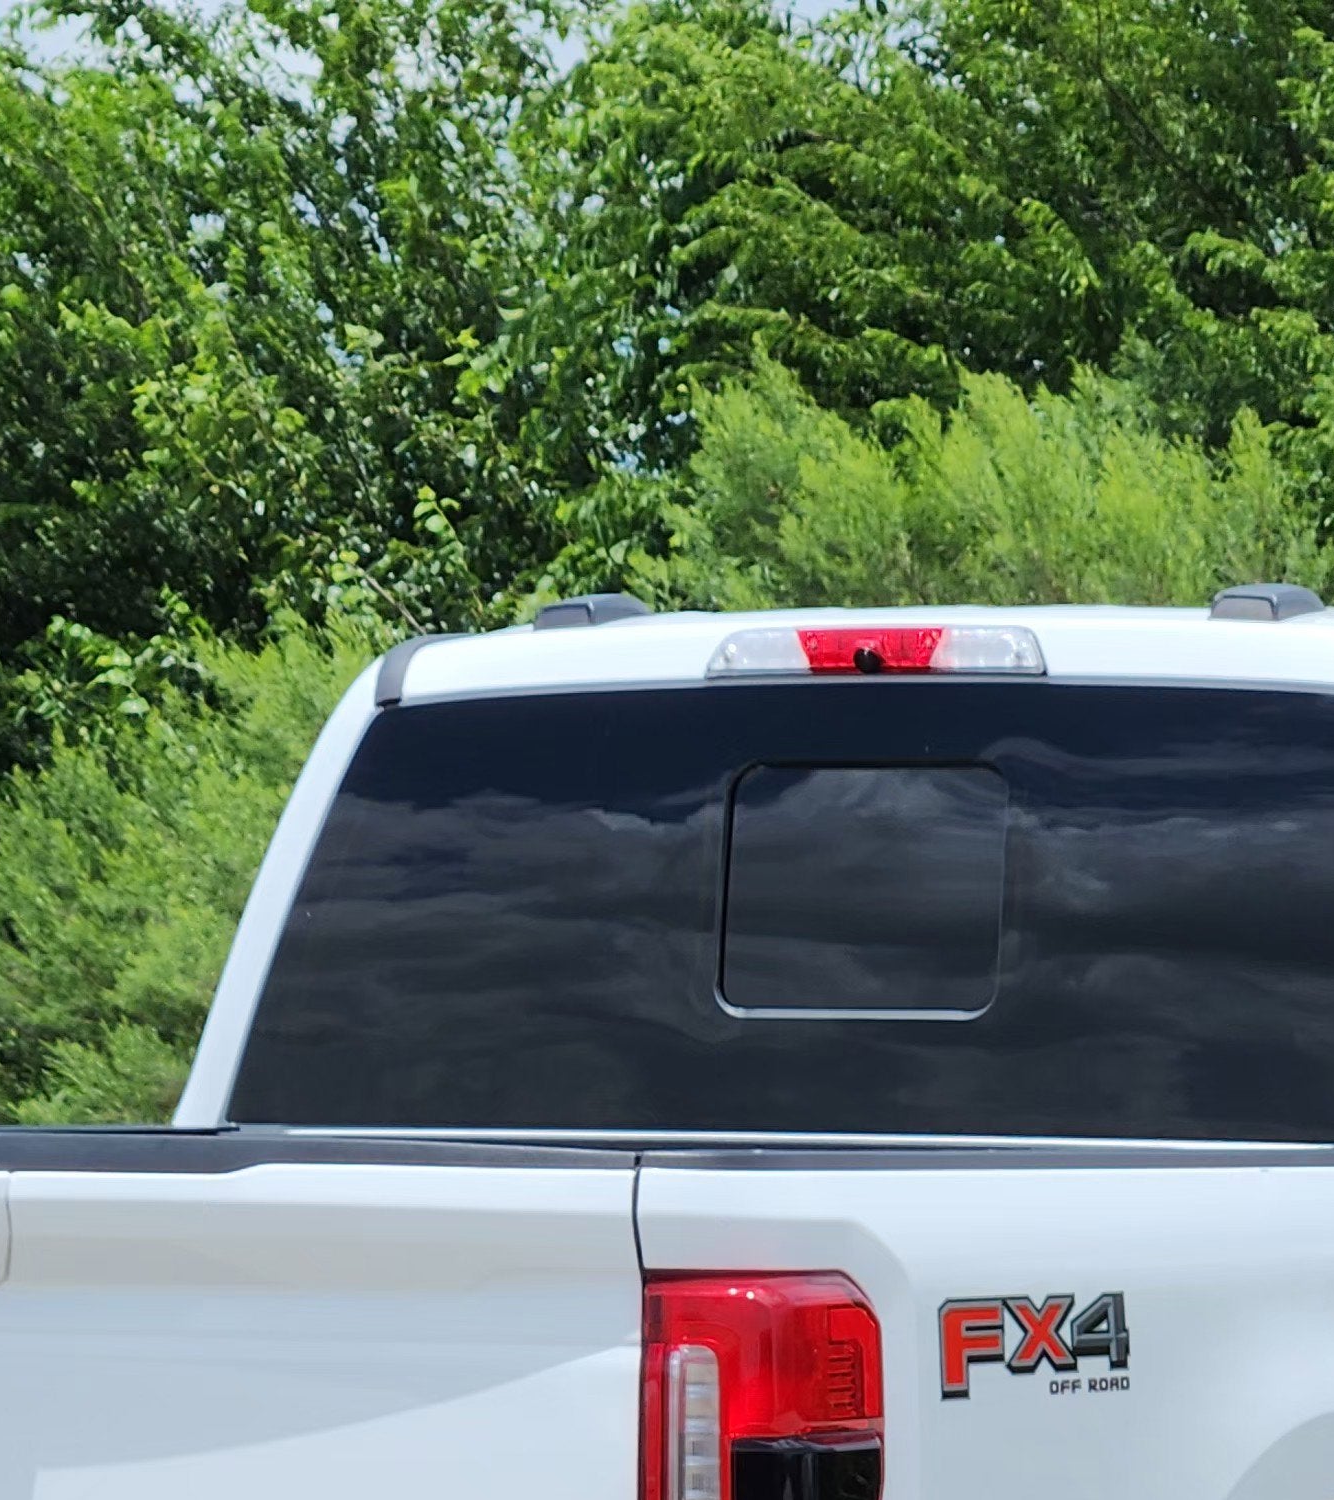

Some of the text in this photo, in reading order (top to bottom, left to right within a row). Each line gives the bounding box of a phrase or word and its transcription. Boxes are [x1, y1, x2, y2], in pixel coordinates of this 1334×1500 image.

[937, 1291, 1130, 1400] FX4
[1049, 1376, 1130, 1395] OFF ROAD
